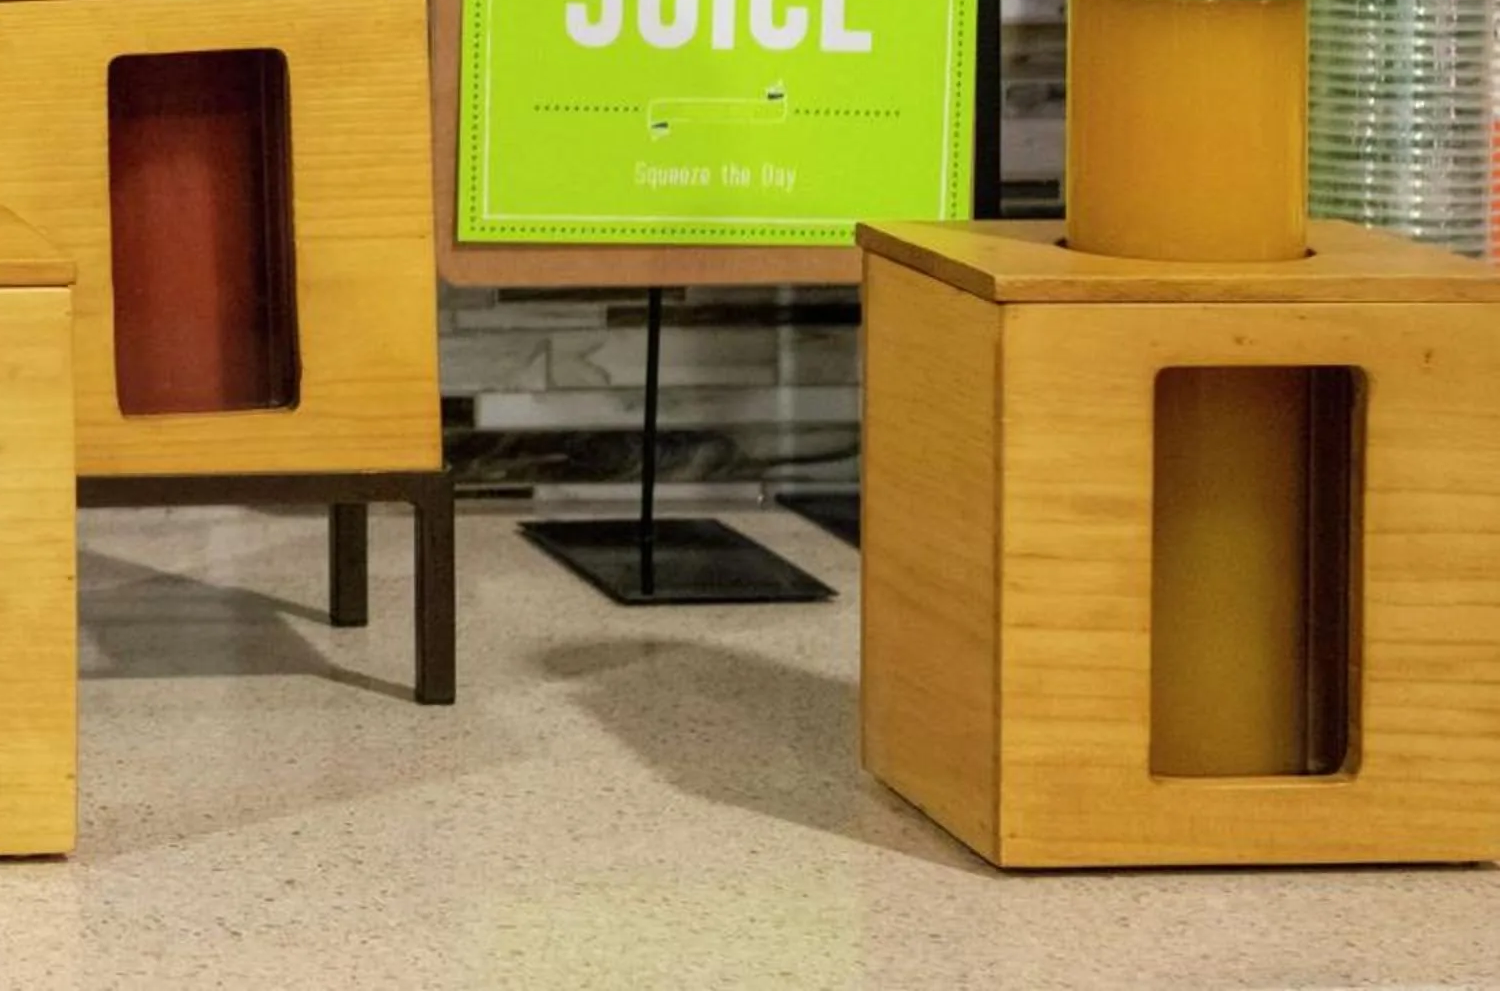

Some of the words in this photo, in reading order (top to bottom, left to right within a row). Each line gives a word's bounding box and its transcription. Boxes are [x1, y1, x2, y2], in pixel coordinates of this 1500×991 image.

[635, 161, 711, 191] Squeeze
[722, 163, 751, 187] the
[762, 163, 797, 192] Day
